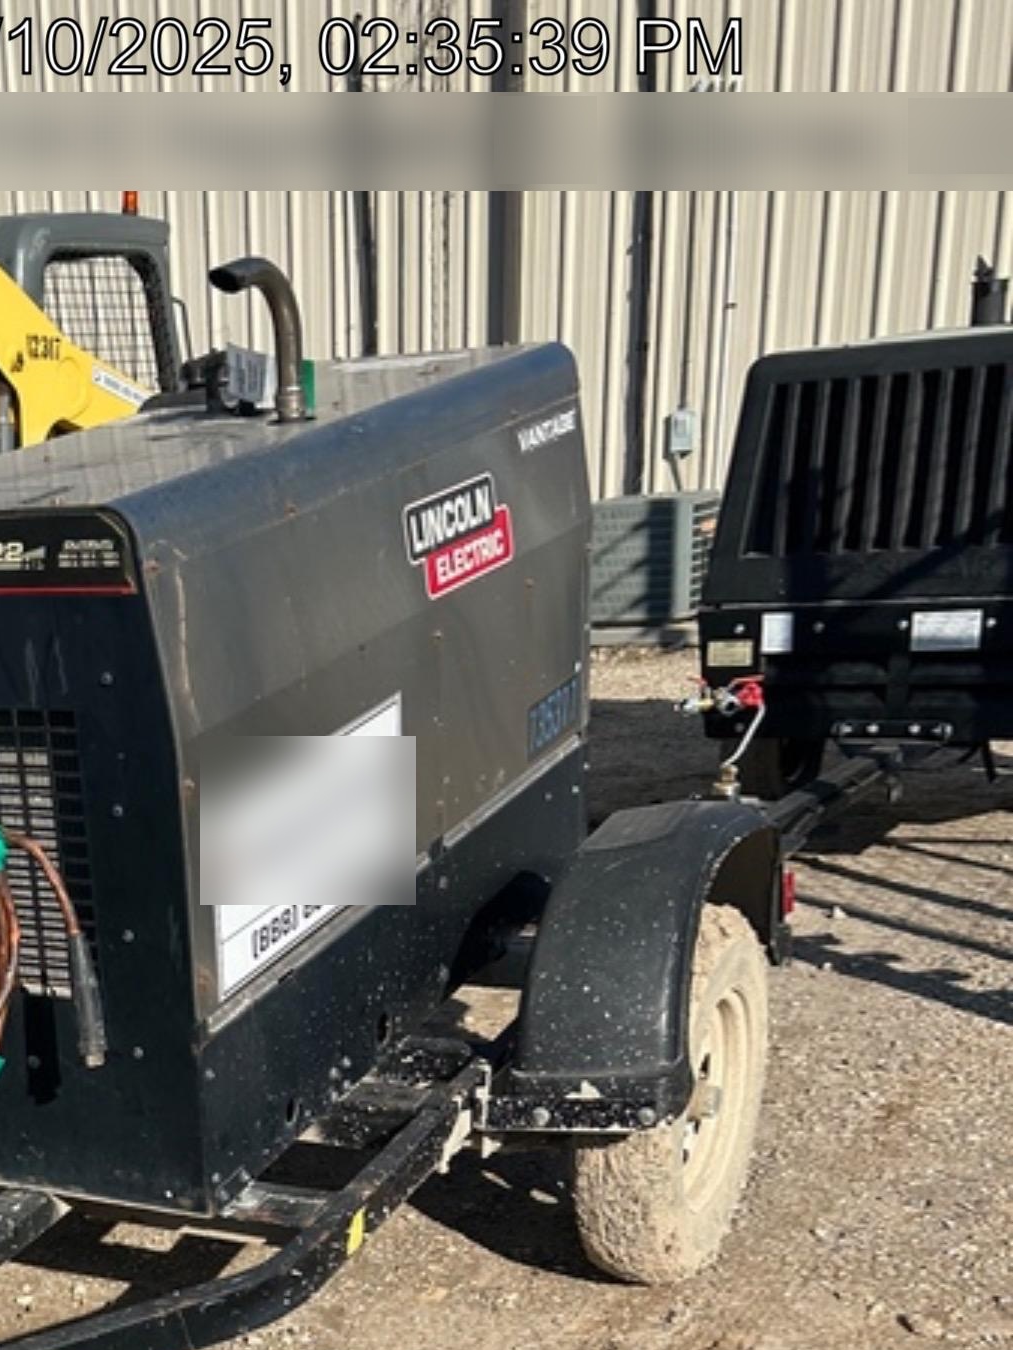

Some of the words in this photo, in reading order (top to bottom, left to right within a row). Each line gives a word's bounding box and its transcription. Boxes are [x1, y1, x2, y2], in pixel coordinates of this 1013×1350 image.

[517, 408, 576, 452] VANTAGE
[409, 484, 493, 554] LINCOLN
[436, 528, 505, 587] ELECTRIC
